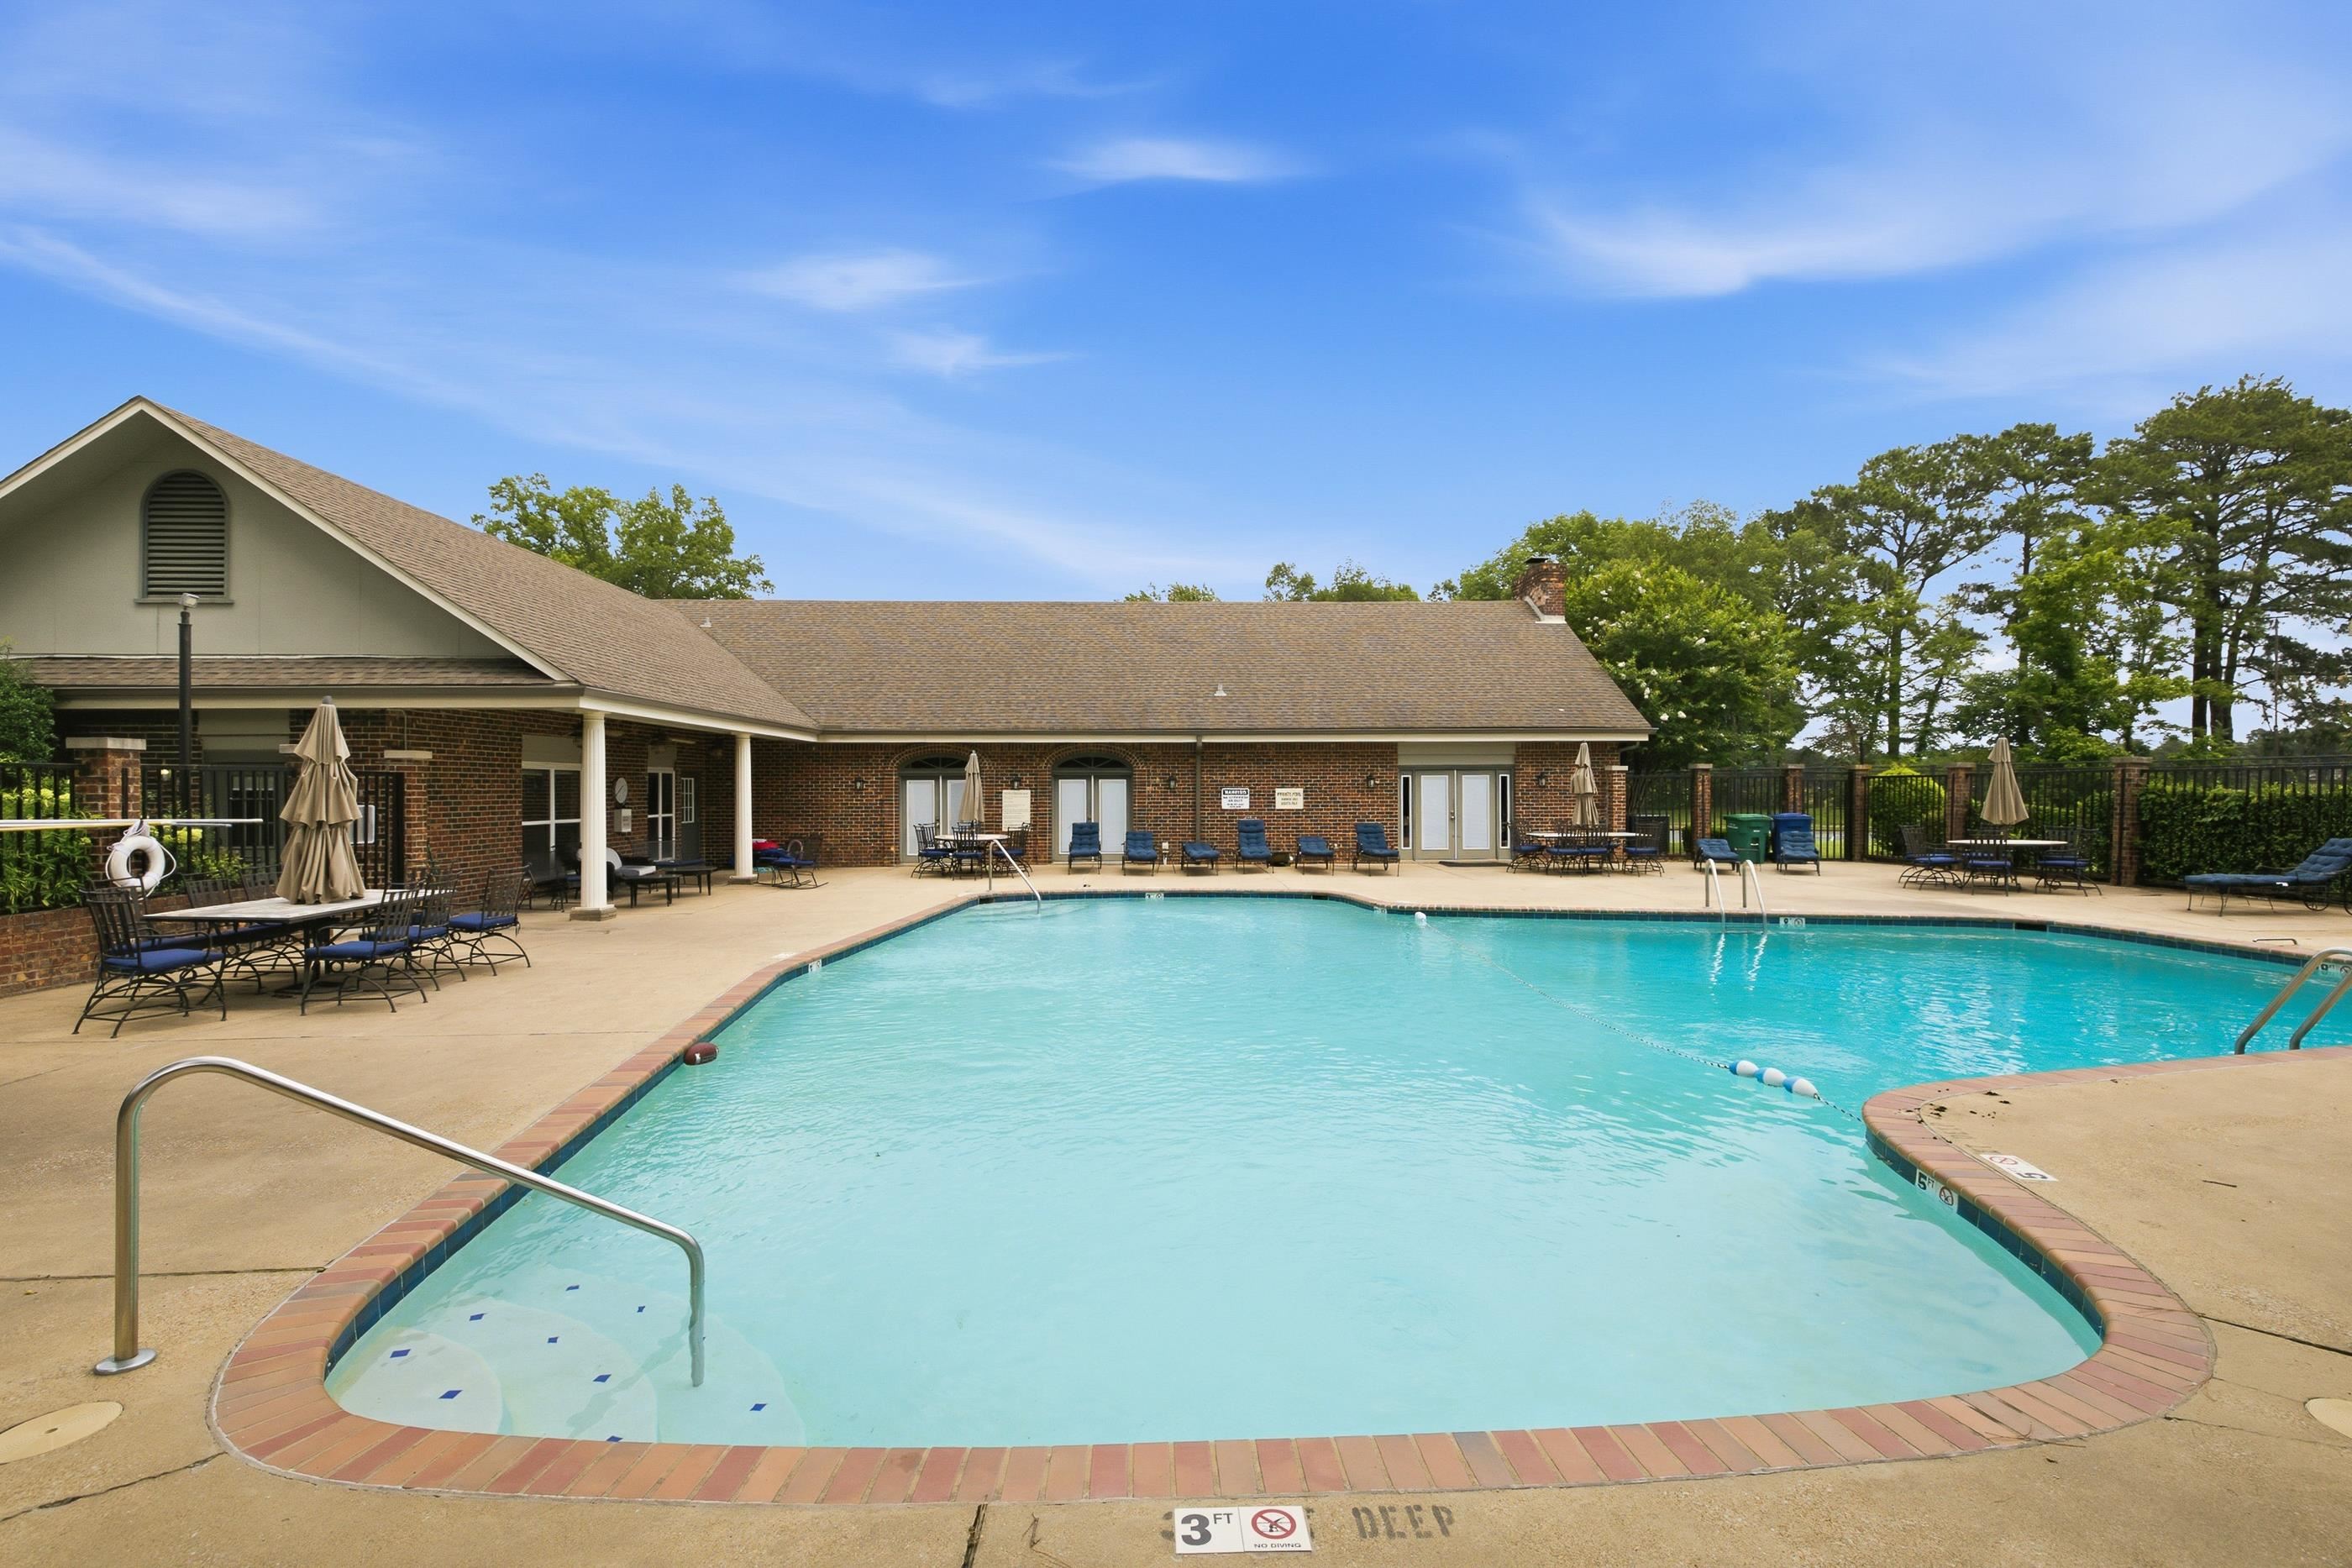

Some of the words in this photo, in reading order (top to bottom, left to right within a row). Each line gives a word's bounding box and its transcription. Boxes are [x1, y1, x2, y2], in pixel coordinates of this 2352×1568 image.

[1917, 1172, 1927, 1191] 5
[1181, 1513, 1212, 1546] 3
[1213, 1513, 1233, 1524] FT
[1351, 1504, 1455, 1539] DEEP
